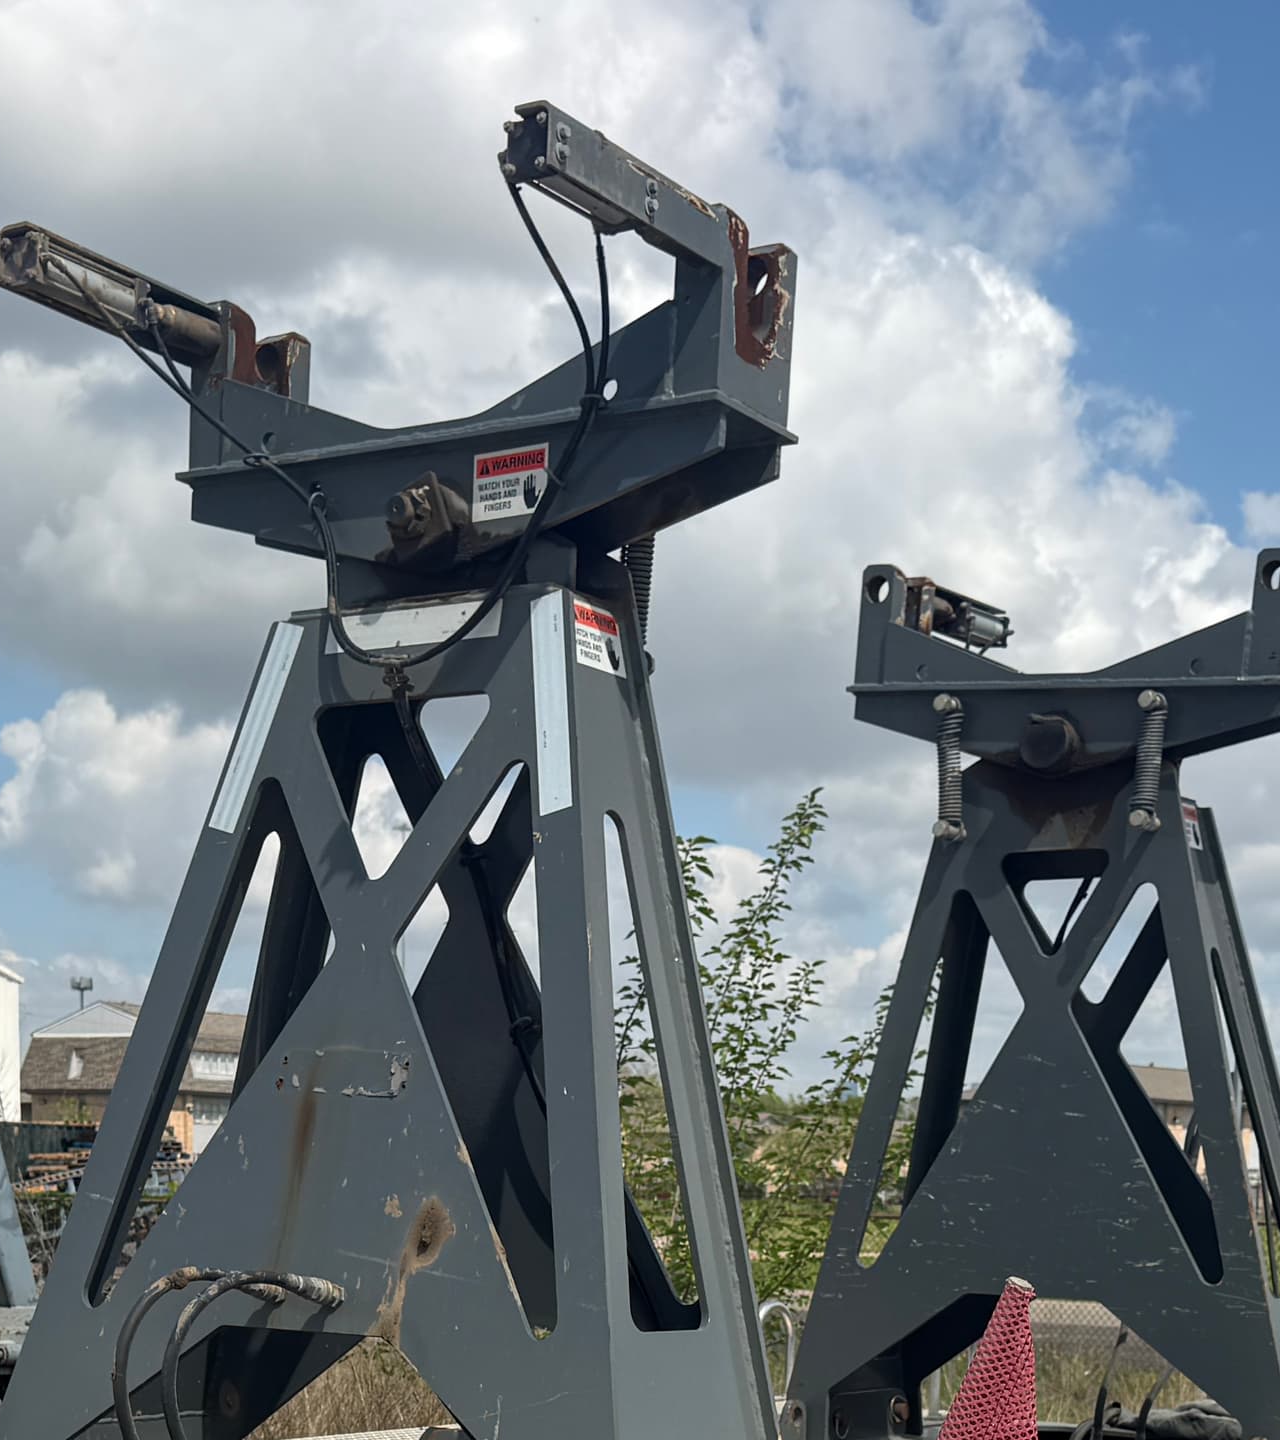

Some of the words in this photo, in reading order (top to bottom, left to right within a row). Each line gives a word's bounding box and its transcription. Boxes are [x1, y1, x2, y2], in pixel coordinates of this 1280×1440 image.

[492, 452, 545, 471] WARNING
[478, 481, 500, 492] WATCH
[502, 477, 520, 489] YOUR
[480, 491, 501, 502] HANDS
[503, 489, 517, 499] AND
[484, 501, 512, 512] FINGERS
[578, 608, 616, 634] WARNING
[577, 628, 589, 639] ATCH
